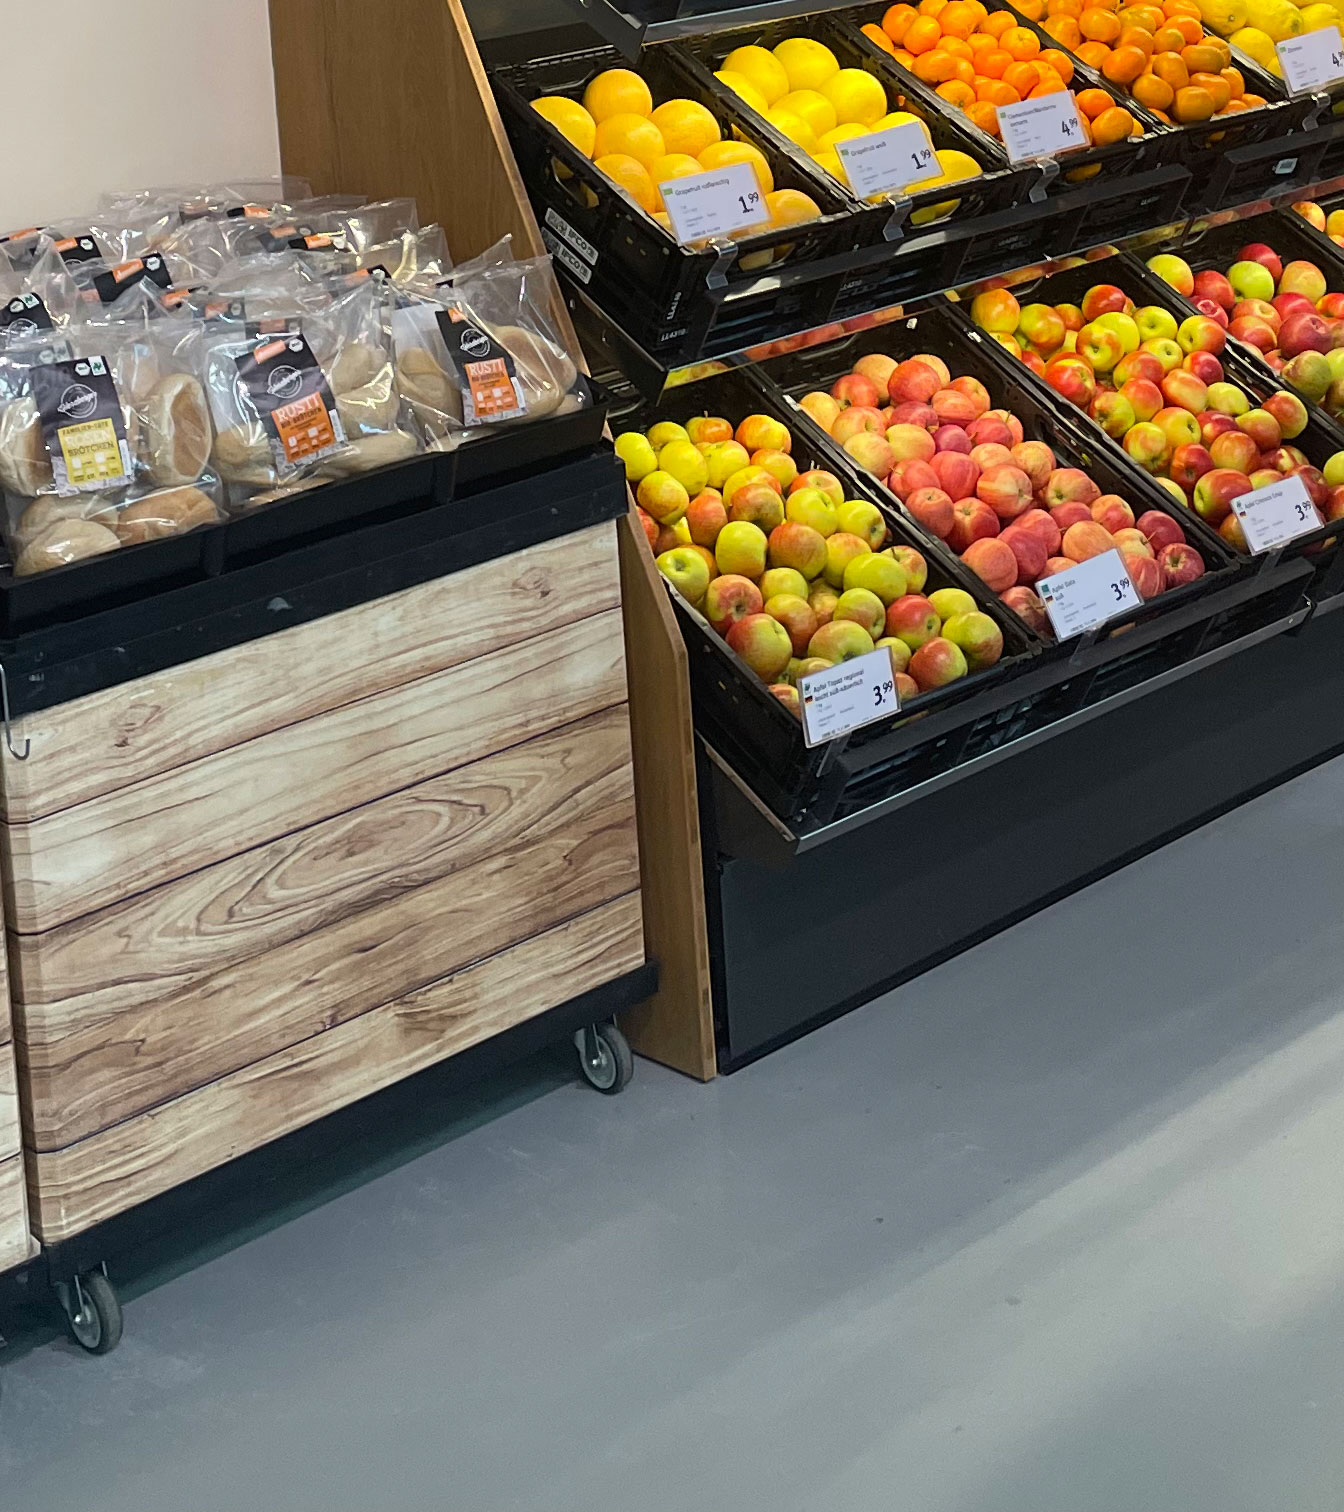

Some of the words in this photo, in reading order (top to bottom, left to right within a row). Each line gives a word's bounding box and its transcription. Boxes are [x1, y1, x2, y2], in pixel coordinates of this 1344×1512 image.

[567, 228, 587, 250] IFCO
[561, 248, 581, 270] IFCO
[468, 359, 503, 376] RUSTI
[68, 441, 115, 457] BRÖTCHEN
